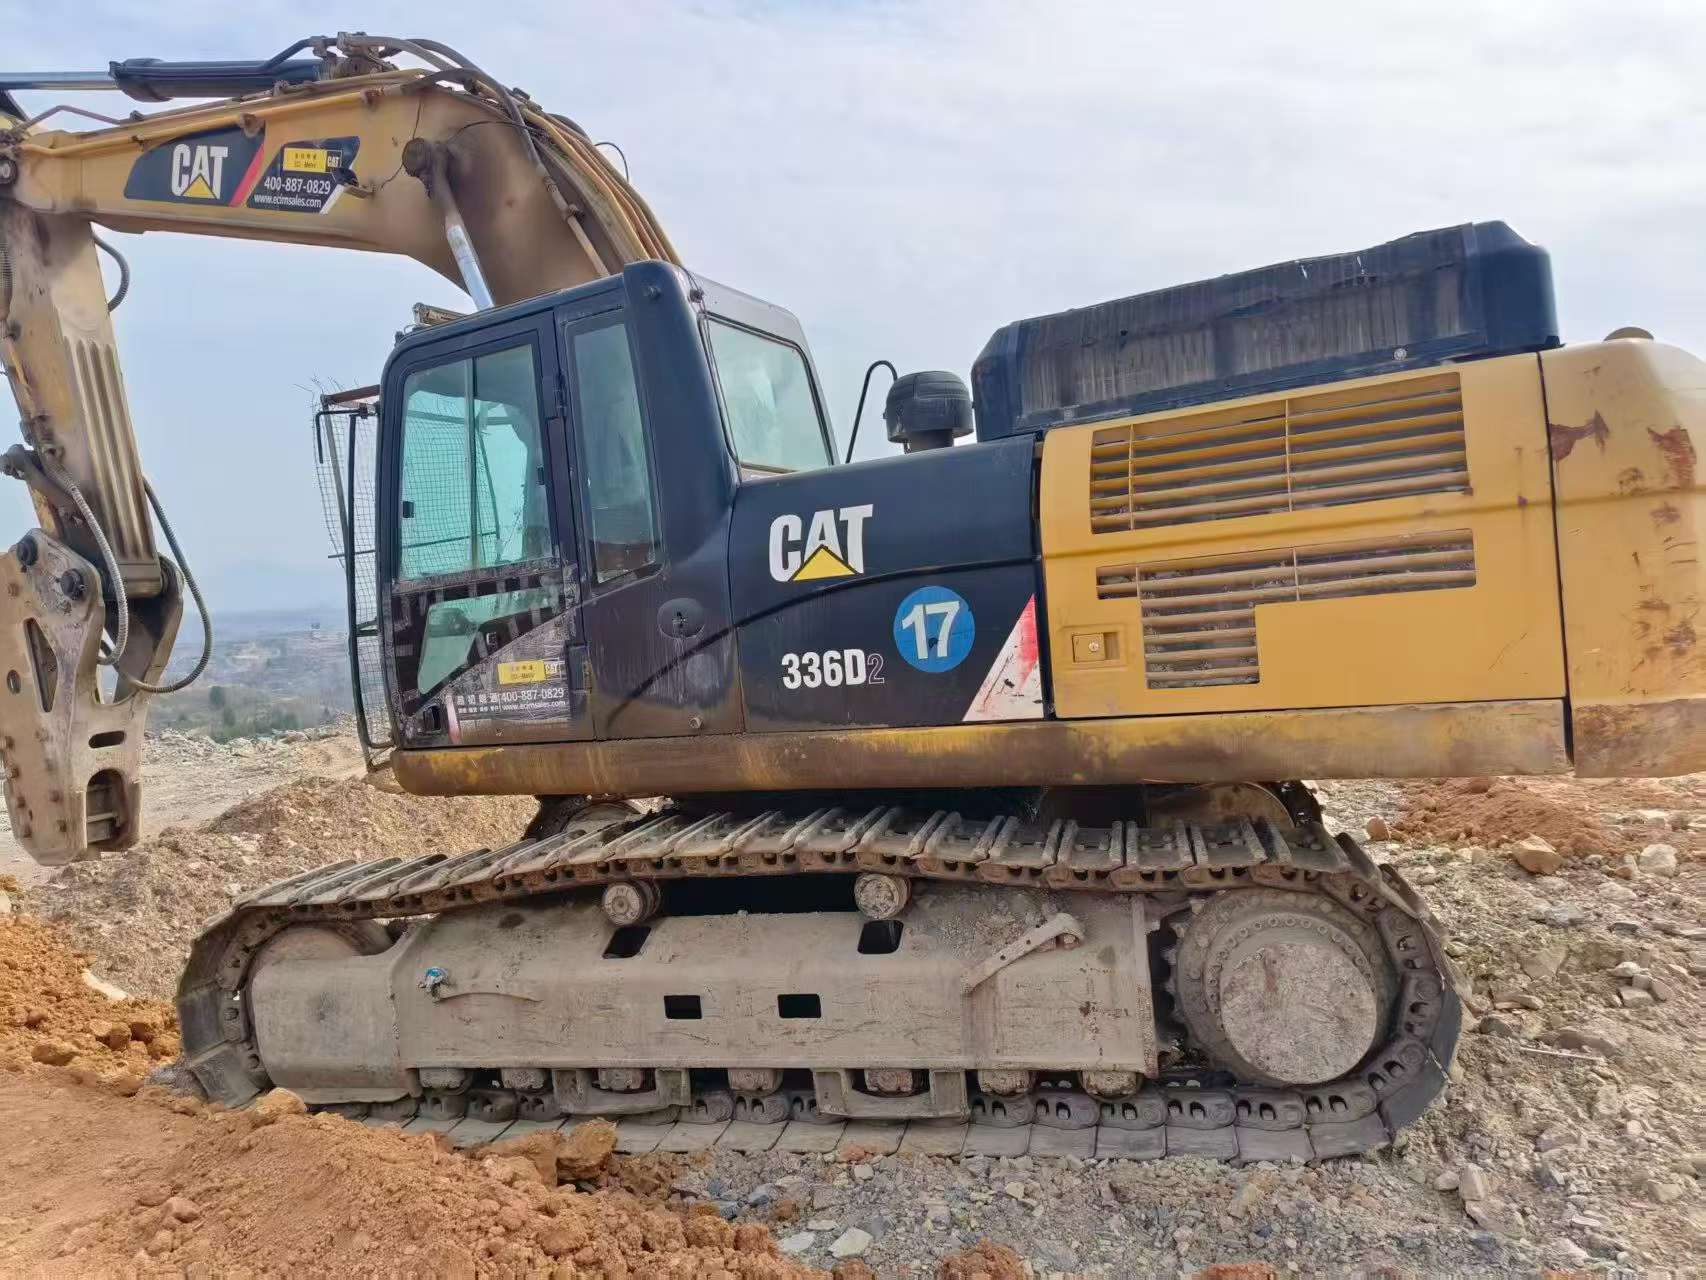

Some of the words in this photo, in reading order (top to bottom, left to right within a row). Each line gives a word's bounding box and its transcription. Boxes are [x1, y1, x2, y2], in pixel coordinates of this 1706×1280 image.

[171, 144, 228, 199] CAT
[327, 156, 340, 167] CAT
[264, 176, 331, 195] 400-887-0829
[254, 194, 322, 208] www.ecimsales.com
[769, 504, 873, 582] CAT
[902, 600, 960, 660] 17
[781, 649, 885, 689] 336D2
[501, 687, 564, 702] 400-887-0829
